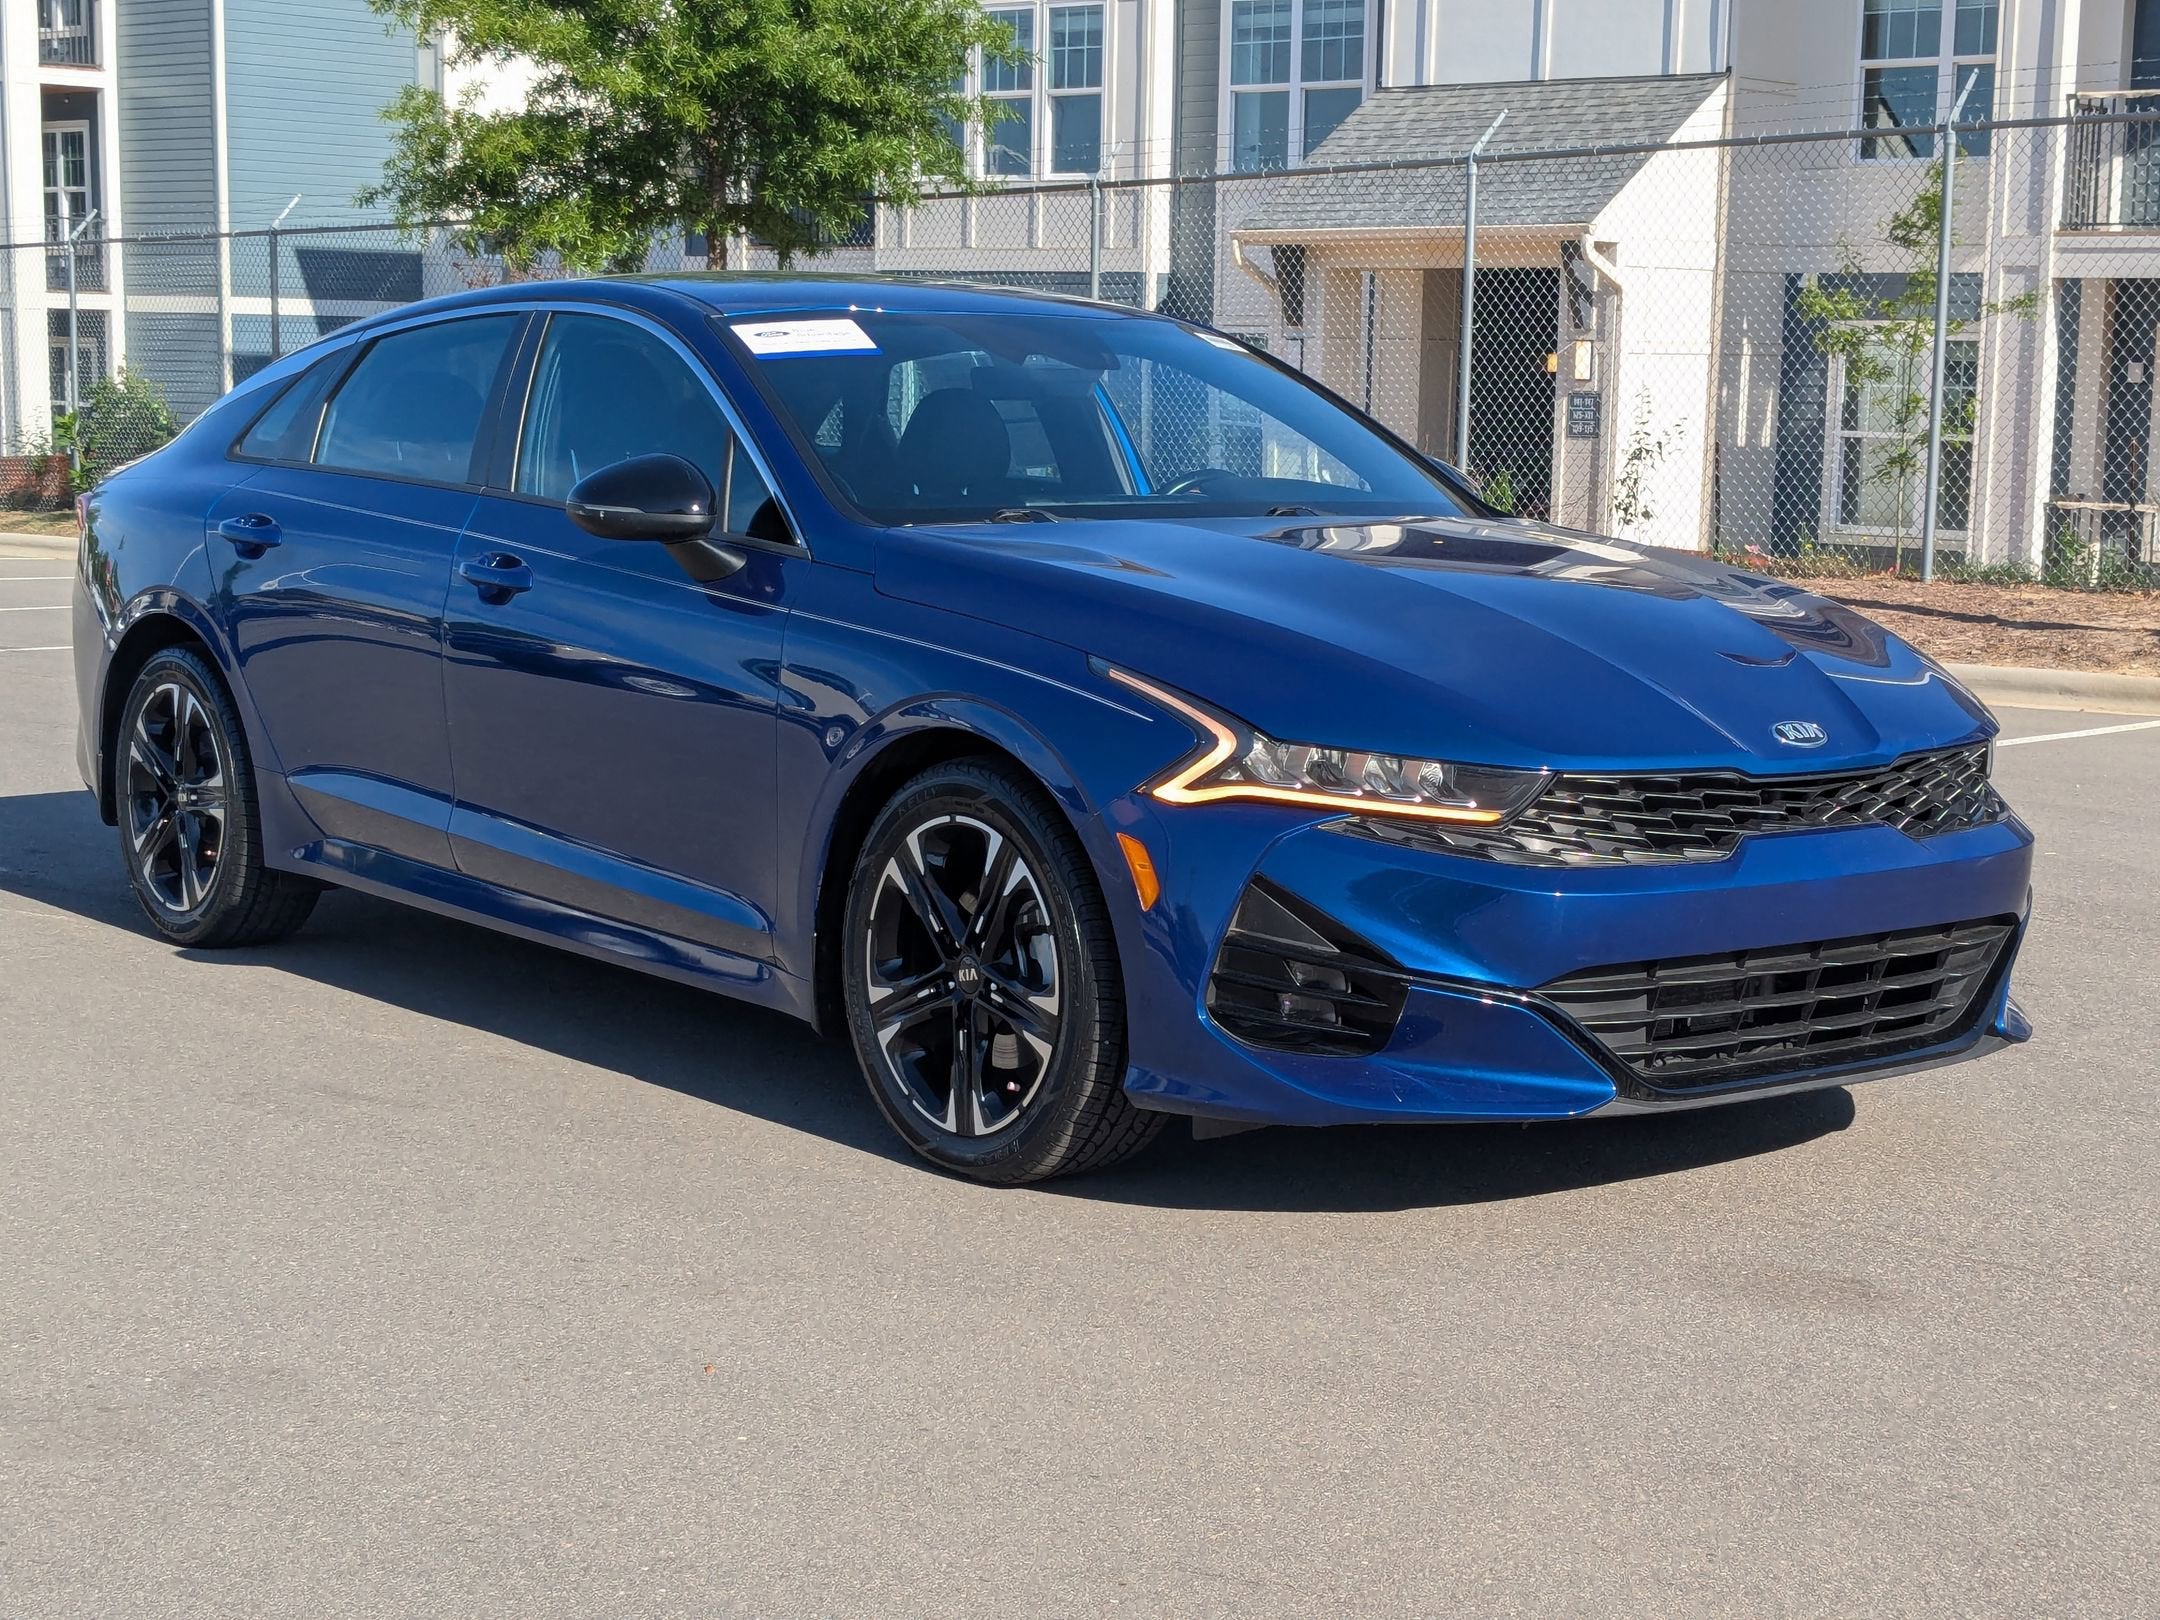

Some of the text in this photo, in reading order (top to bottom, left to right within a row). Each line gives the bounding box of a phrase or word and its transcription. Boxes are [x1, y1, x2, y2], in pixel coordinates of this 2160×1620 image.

[1777, 723, 1823, 740] KIA
[898, 785, 938, 817] KELLY
[958, 967, 978, 982] KIA
